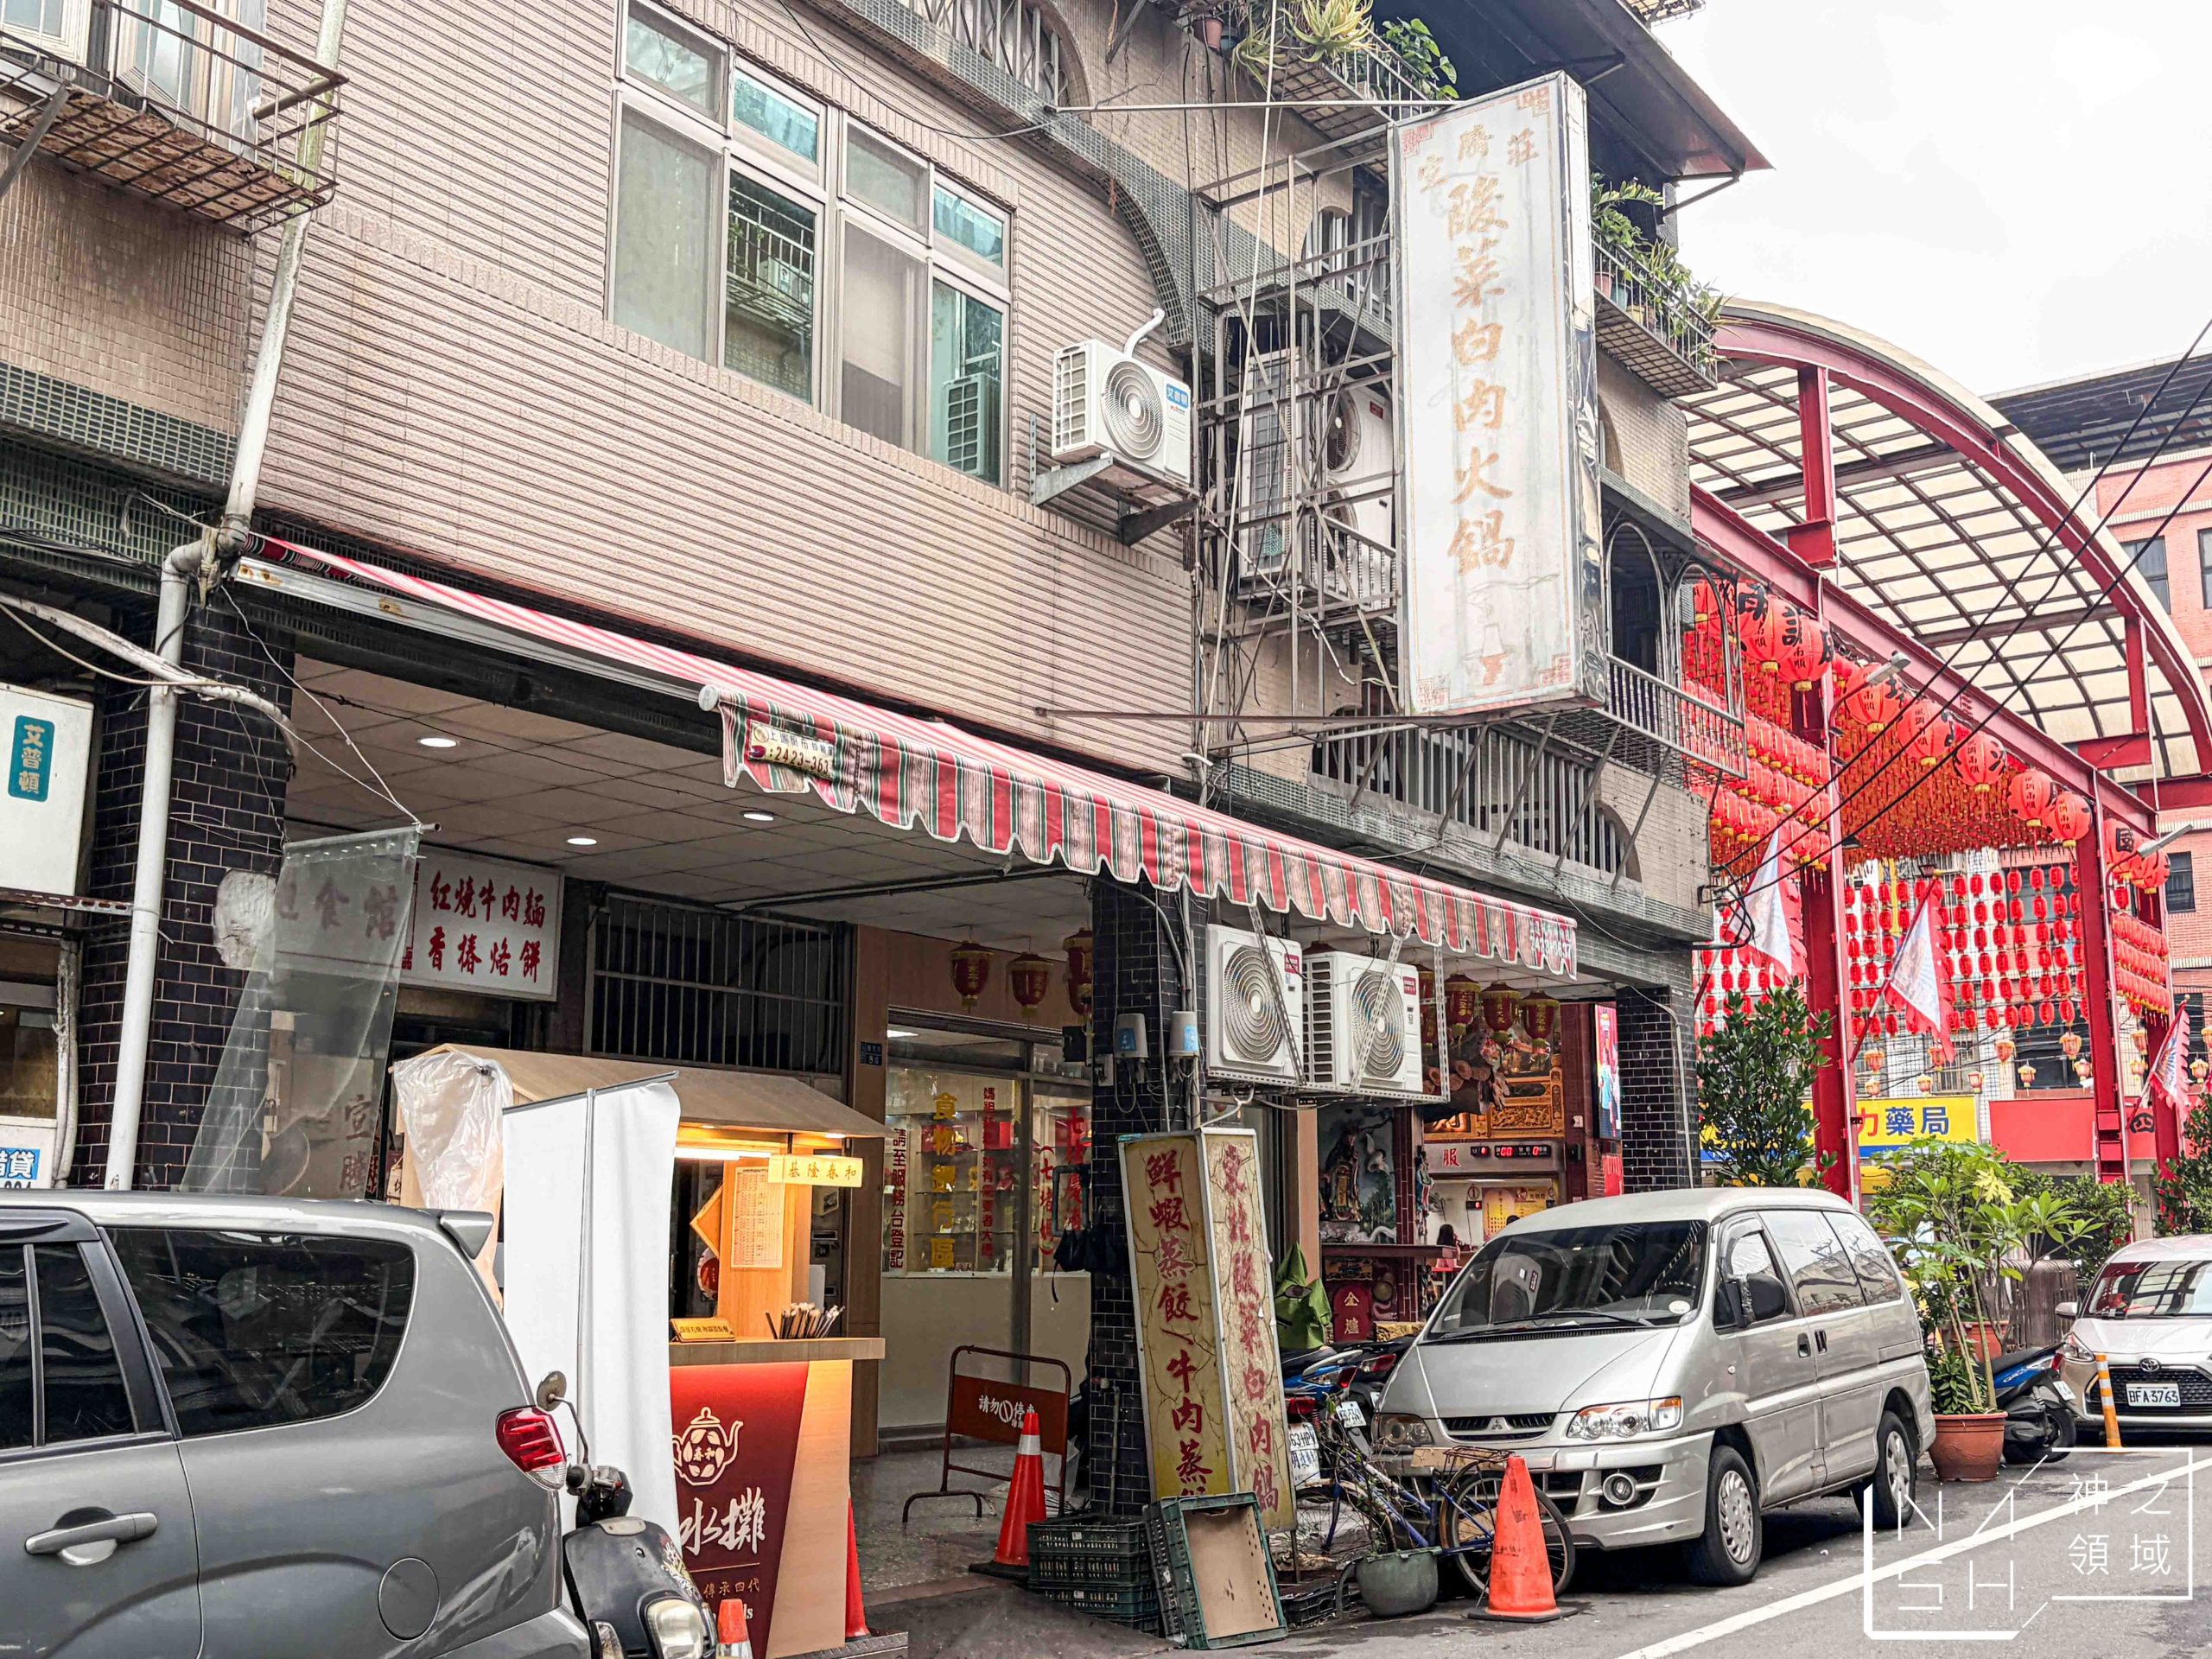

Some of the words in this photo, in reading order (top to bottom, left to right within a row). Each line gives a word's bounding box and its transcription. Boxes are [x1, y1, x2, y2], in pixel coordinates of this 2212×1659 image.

[1446, 175, 1515, 577] 酸菜白肉火鍋
[431, 870, 546, 929] 紅燒牛肉麵
[429, 925, 542, 983] 香椿烙餅
[1147, 1148, 1213, 1496] 鮮蝦蒸餃、牛肉蒸
[693, 1446, 715, 1461] 春和
